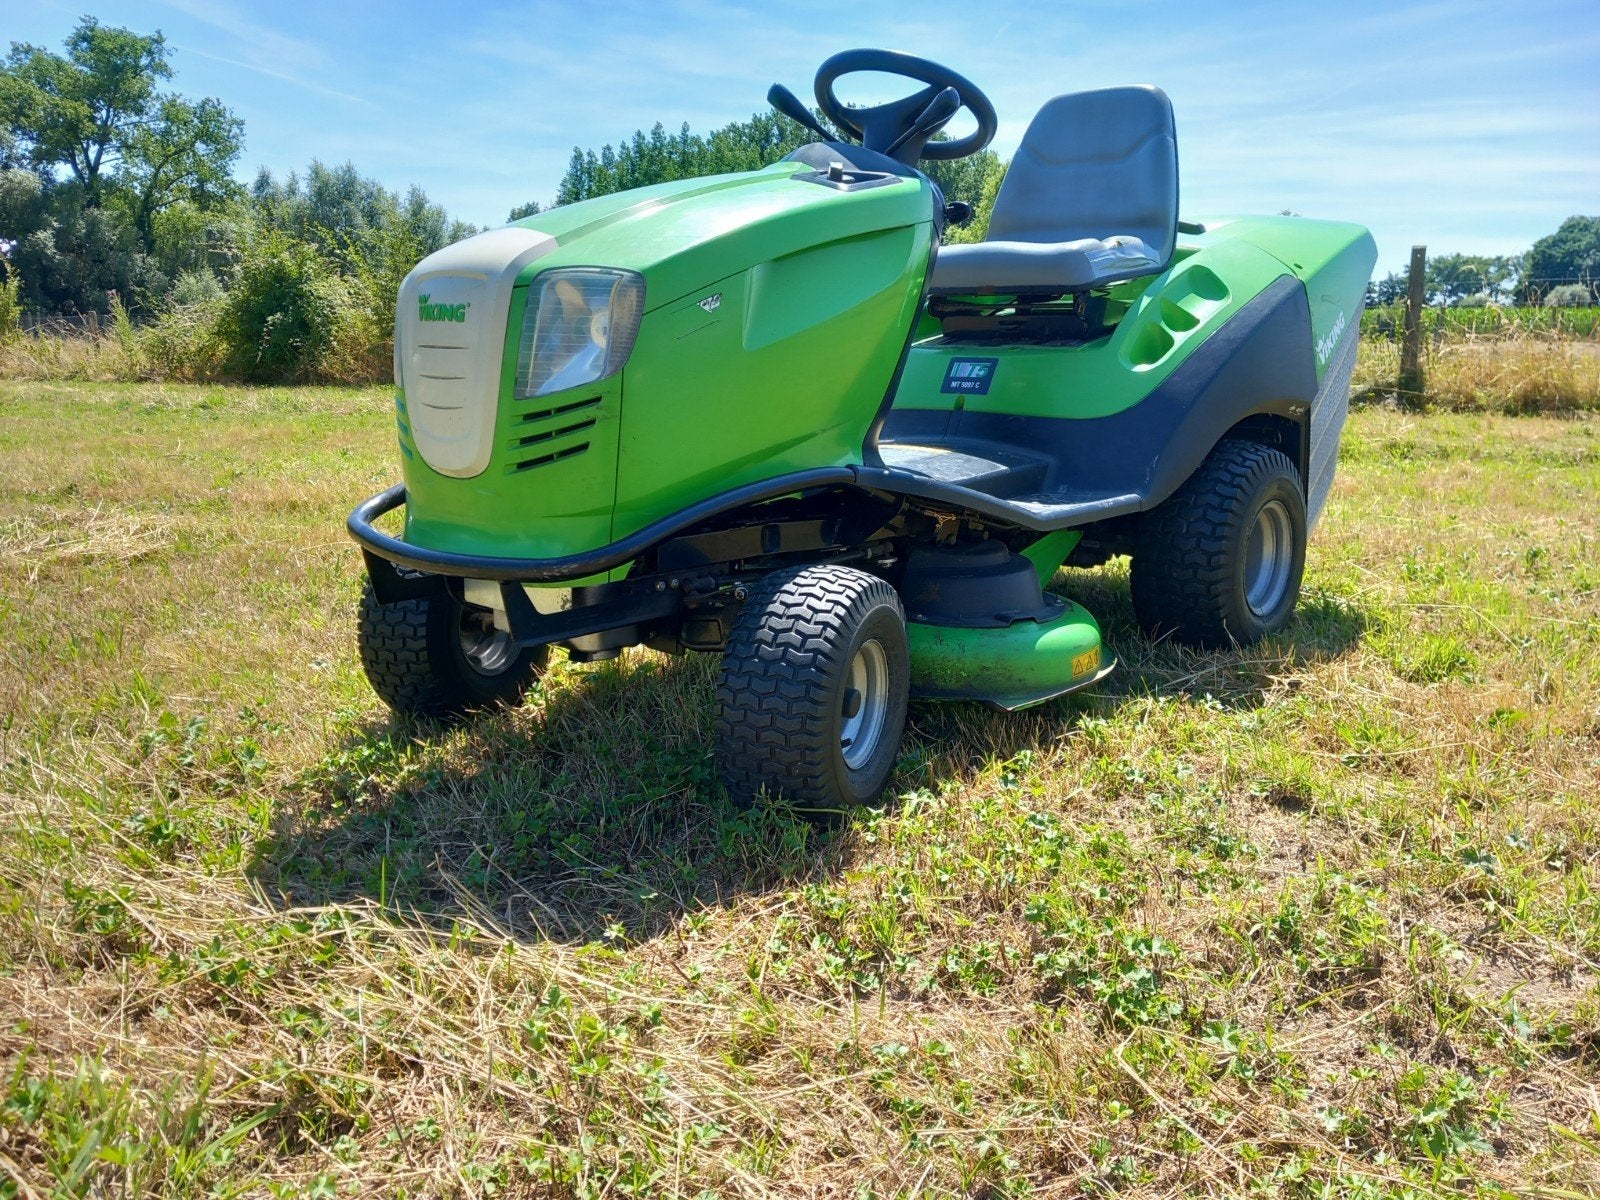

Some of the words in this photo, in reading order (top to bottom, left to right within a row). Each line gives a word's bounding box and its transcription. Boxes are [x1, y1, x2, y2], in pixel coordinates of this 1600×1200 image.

[418, 293, 466, 323] VIKING
[1315, 310, 1346, 365] VIKING
[975, 381, 981, 389] C
